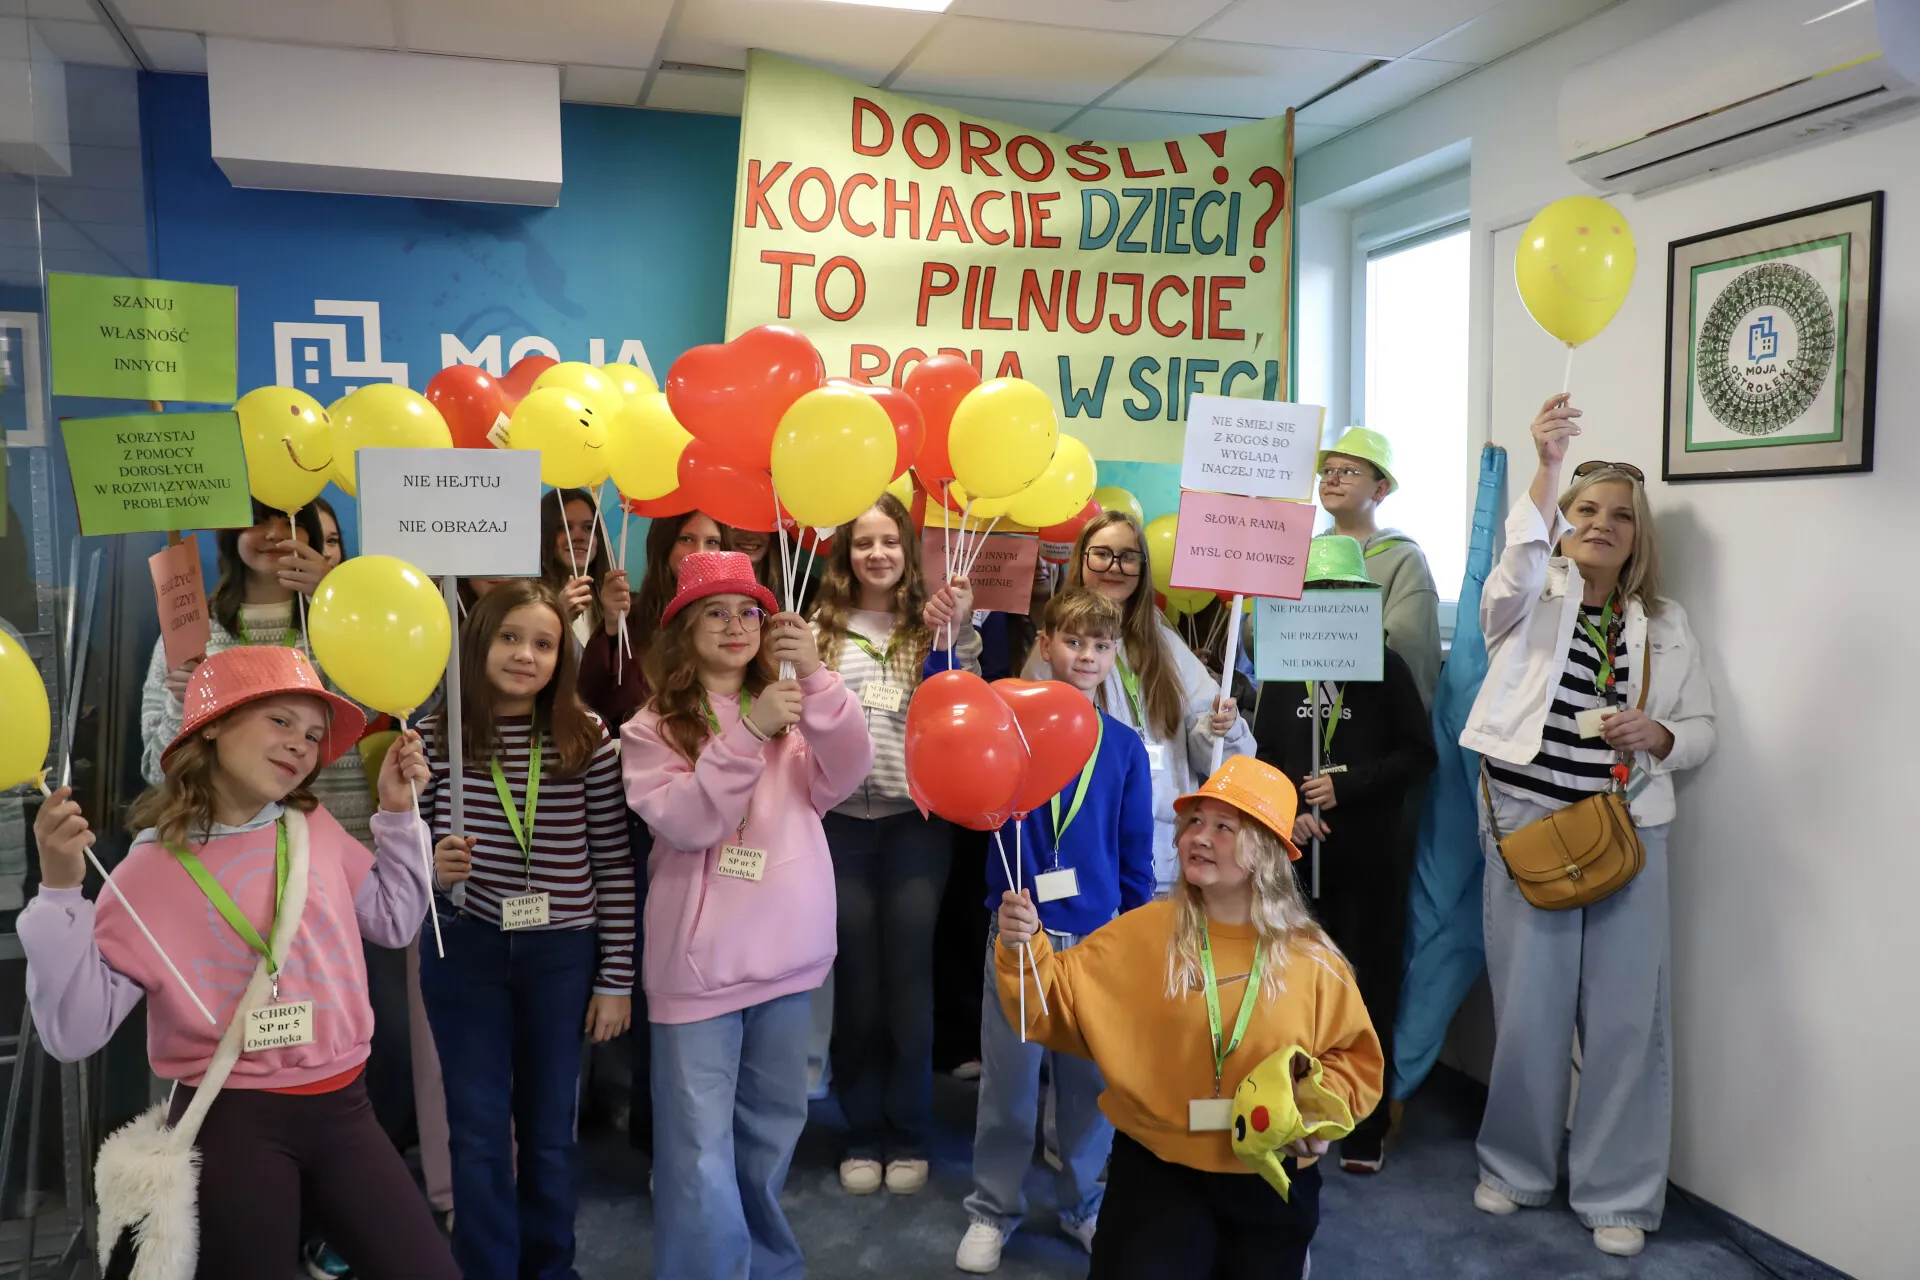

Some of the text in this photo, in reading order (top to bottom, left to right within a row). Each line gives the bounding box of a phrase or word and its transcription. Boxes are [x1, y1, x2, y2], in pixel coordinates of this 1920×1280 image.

[852, 96, 1228, 185] DOROŚLI!
[744, 158, 1062, 249] KOCHACIE
[113, 295, 174, 311] SZANUJ
[760, 250, 1266, 354] TO PILNUJCIE,
[100, 325, 190, 343] WŁASNOŚĆ
[114, 358, 177, 373] INNYCH
[1746, 364, 1777, 376] MOJA
[1058, 355, 1115, 420] W
[1211, 416, 1296, 433] NIE ŚMIEJ SIĘ
[116, 430, 196, 444] KORZYSTAJ
[1214, 432, 1290, 448] Z KOGOŚ BO
[123, 447, 195, 460] Z POMOCY
[1220, 448, 1279, 464] WYGLĄDA
[119, 463, 204, 477] DOROSŁYCH
[1201, 463, 1294, 480] INACZEJ NIŻ TY
[94, 478, 231, 495] W ROZWIĄZYWANIU
[403, 475, 501, 488] NIE HEJTUJ
[123, 493, 210, 510] PROBLEMÓW
[398, 518, 508, 533] NIE OBRAŻAJ
[1204, 513, 1246, 527] SŁOWA
[984, 551, 1018, 561] INNYM
[1190, 546, 1296, 566] MYŚL CO MÓWISZ
[1270, 604, 1287, 614] NIE
[1280, 632, 1359, 641] NIE PRZEZYWAJ
[1282, 658, 1356, 668] NIE DOKUCZAJ
[726, 847, 763, 859] SCHRON
[506, 896, 544, 908] SCHRON
[512, 909, 522, 918] SP
[252, 1004, 306, 1020] SCHRON
[258, 1023, 274, 1034] SP
[293, 1019, 300, 1028] 5
